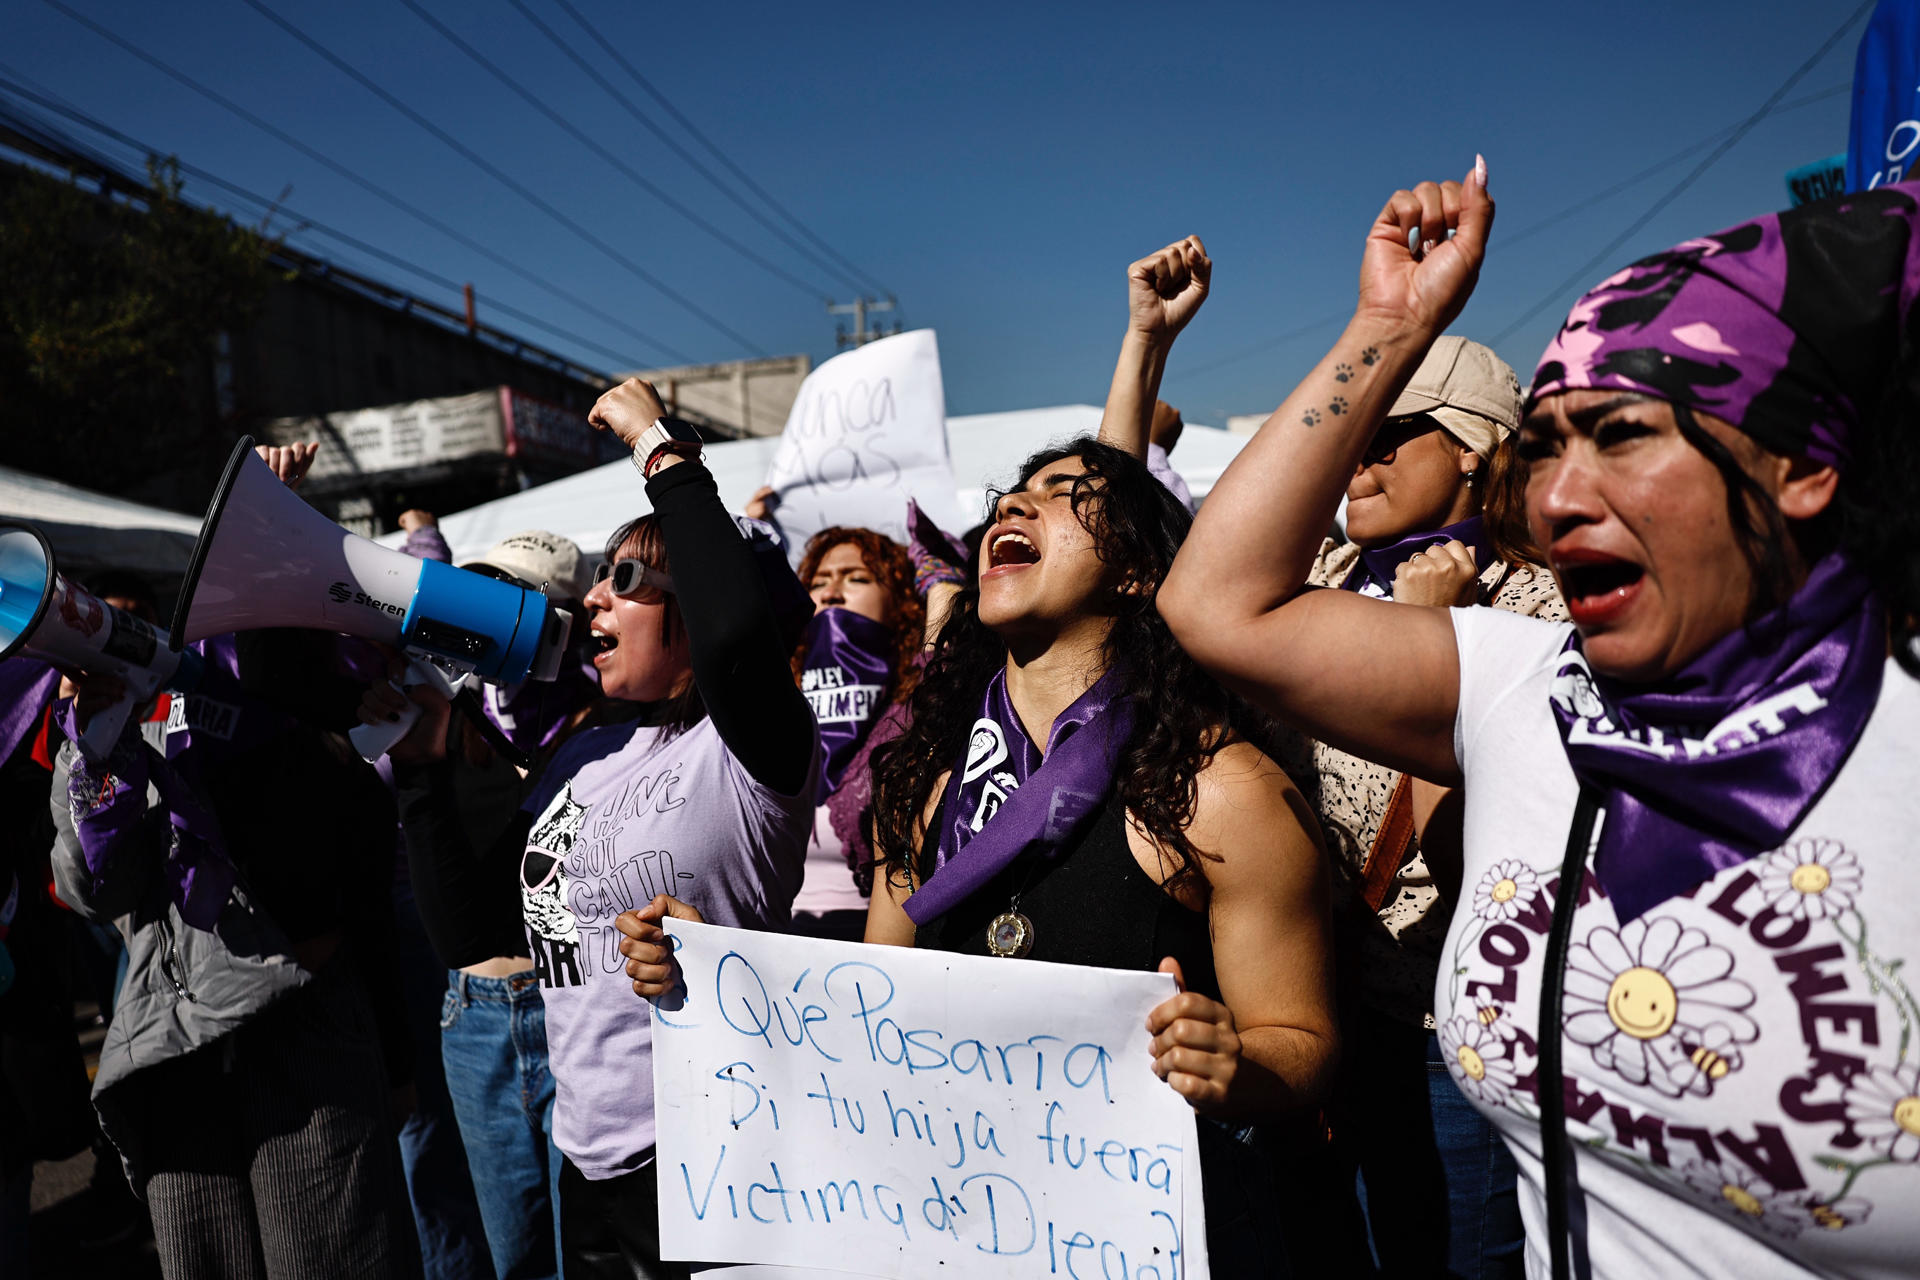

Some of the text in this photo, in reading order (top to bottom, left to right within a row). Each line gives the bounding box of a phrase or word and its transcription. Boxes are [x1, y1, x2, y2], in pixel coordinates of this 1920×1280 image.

[800, 376, 897, 439] unca
[354, 592, 406, 617] Steren
[806, 688, 880, 721] LIMPI
[563, 827, 624, 878] GOT
[567, 850, 695, 925] CATTI-
[1682, 868, 1880, 1150] LOWERS
[715, 1061, 779, 1131] Si
[807, 1072, 865, 1134] tu
[883, 1089, 1006, 1169] hija
